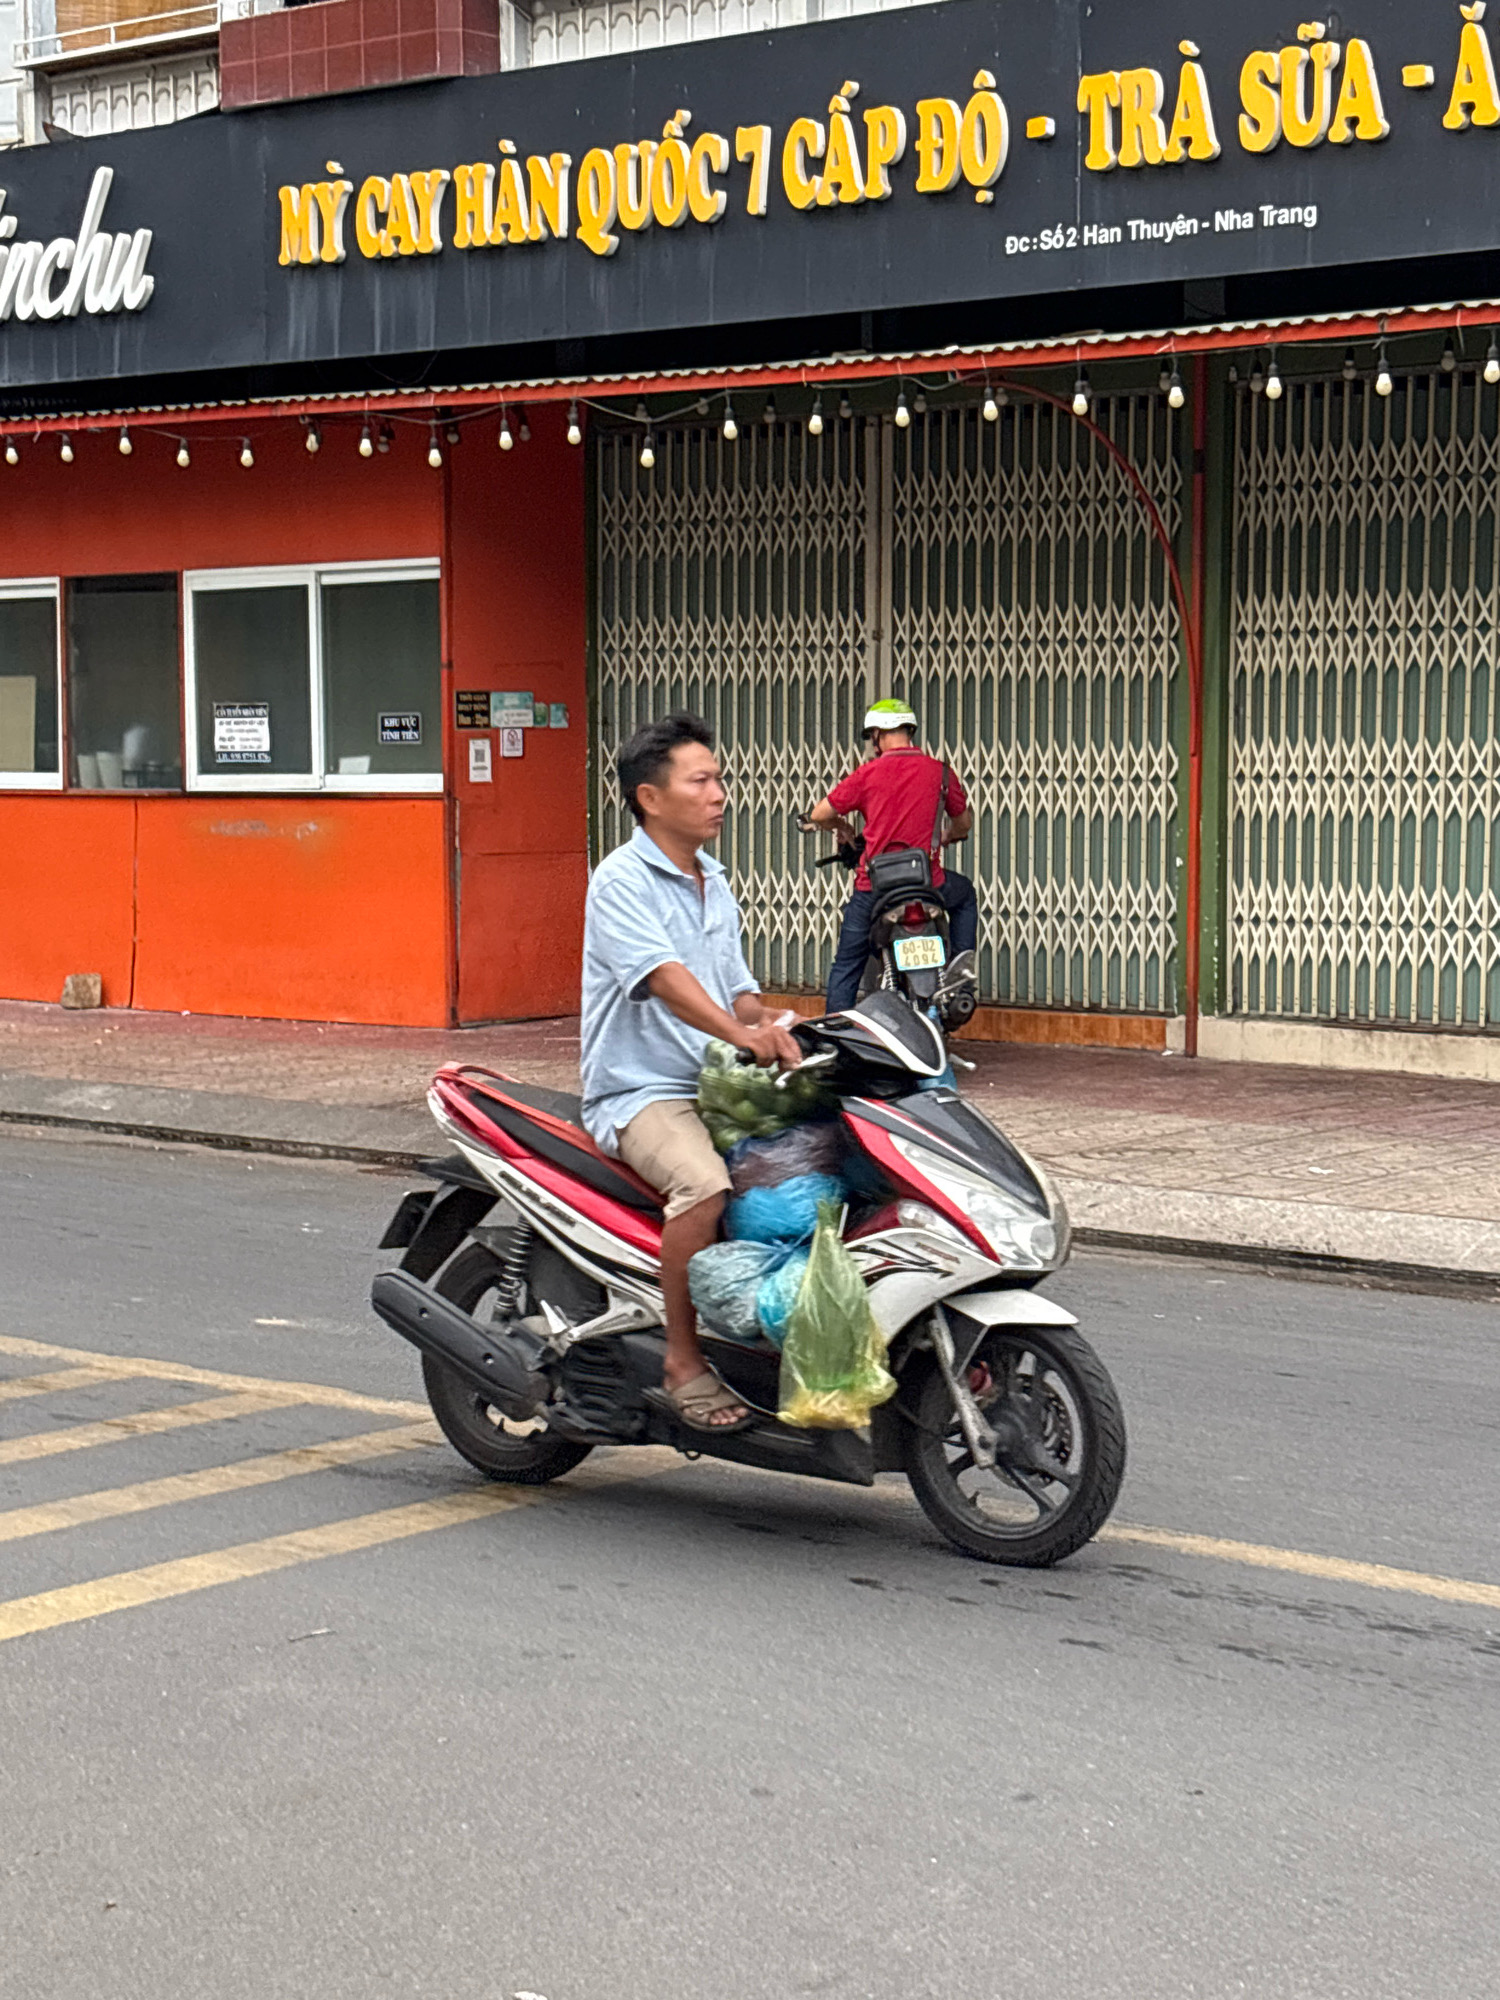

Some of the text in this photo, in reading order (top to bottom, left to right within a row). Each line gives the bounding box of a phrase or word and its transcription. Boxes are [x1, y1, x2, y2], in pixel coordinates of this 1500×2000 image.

[355, 169, 450, 259] CAY
[453, 139, 572, 248] HÀN
[576, 109, 729, 256] QUỐC
[735, 124, 772, 216] 7
[782, 80, 907, 210] CẤP
[915, 69, 1009, 205] ĐỘ
[1077, 39, 1221, 171] TRÀ
[1238, 21, 1390, 153] SỮA
[1127, 214, 1198, 243] Thuyên
[1214, 210, 1254, 232] Nha
[1259, 205, 1318, 228] Trang
[384, 717, 400, 727] KHU
[905, 953, 938, 967] 4094
